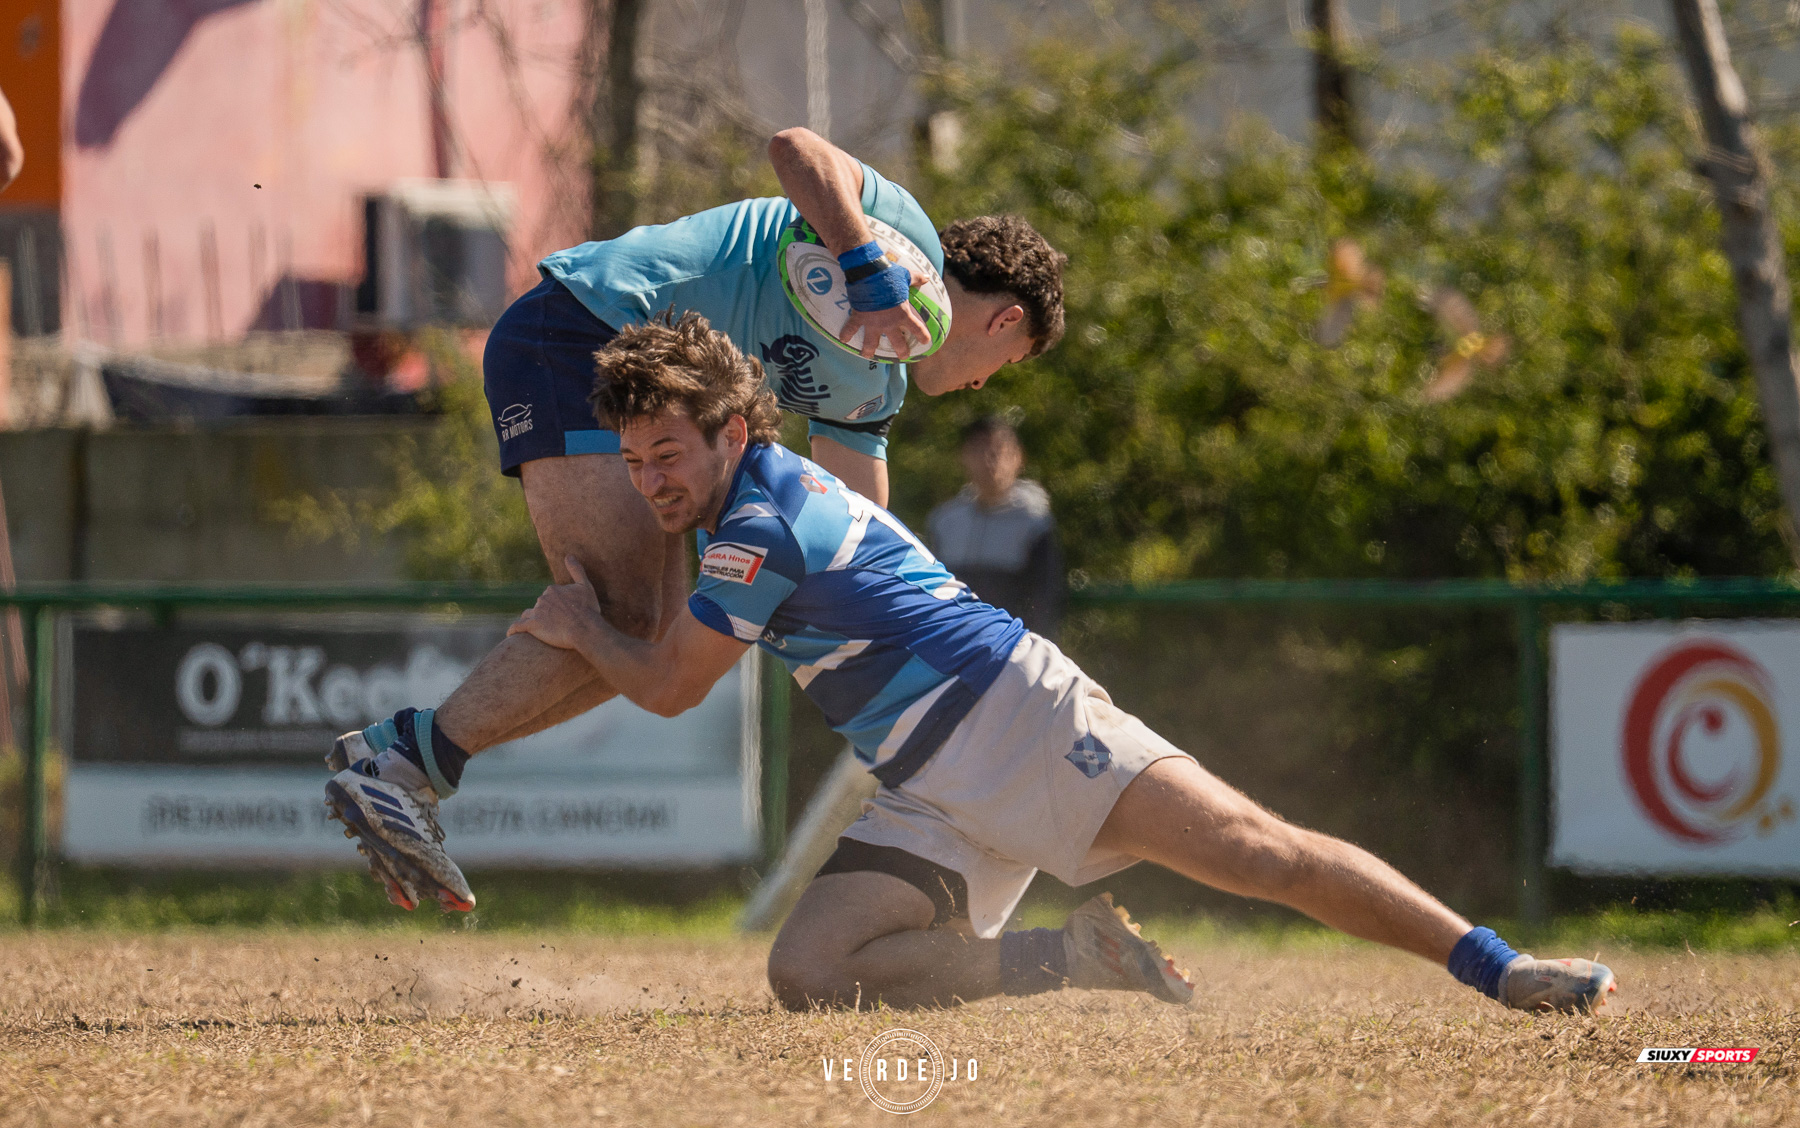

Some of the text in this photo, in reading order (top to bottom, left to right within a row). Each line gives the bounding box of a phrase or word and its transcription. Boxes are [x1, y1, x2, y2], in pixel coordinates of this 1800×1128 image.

[868, 220, 946, 299] LBERT
[509, 419, 533, 438] MOTORS
[728, 554, 751, 565] Hnos
[729, 567, 744, 575] PARA
